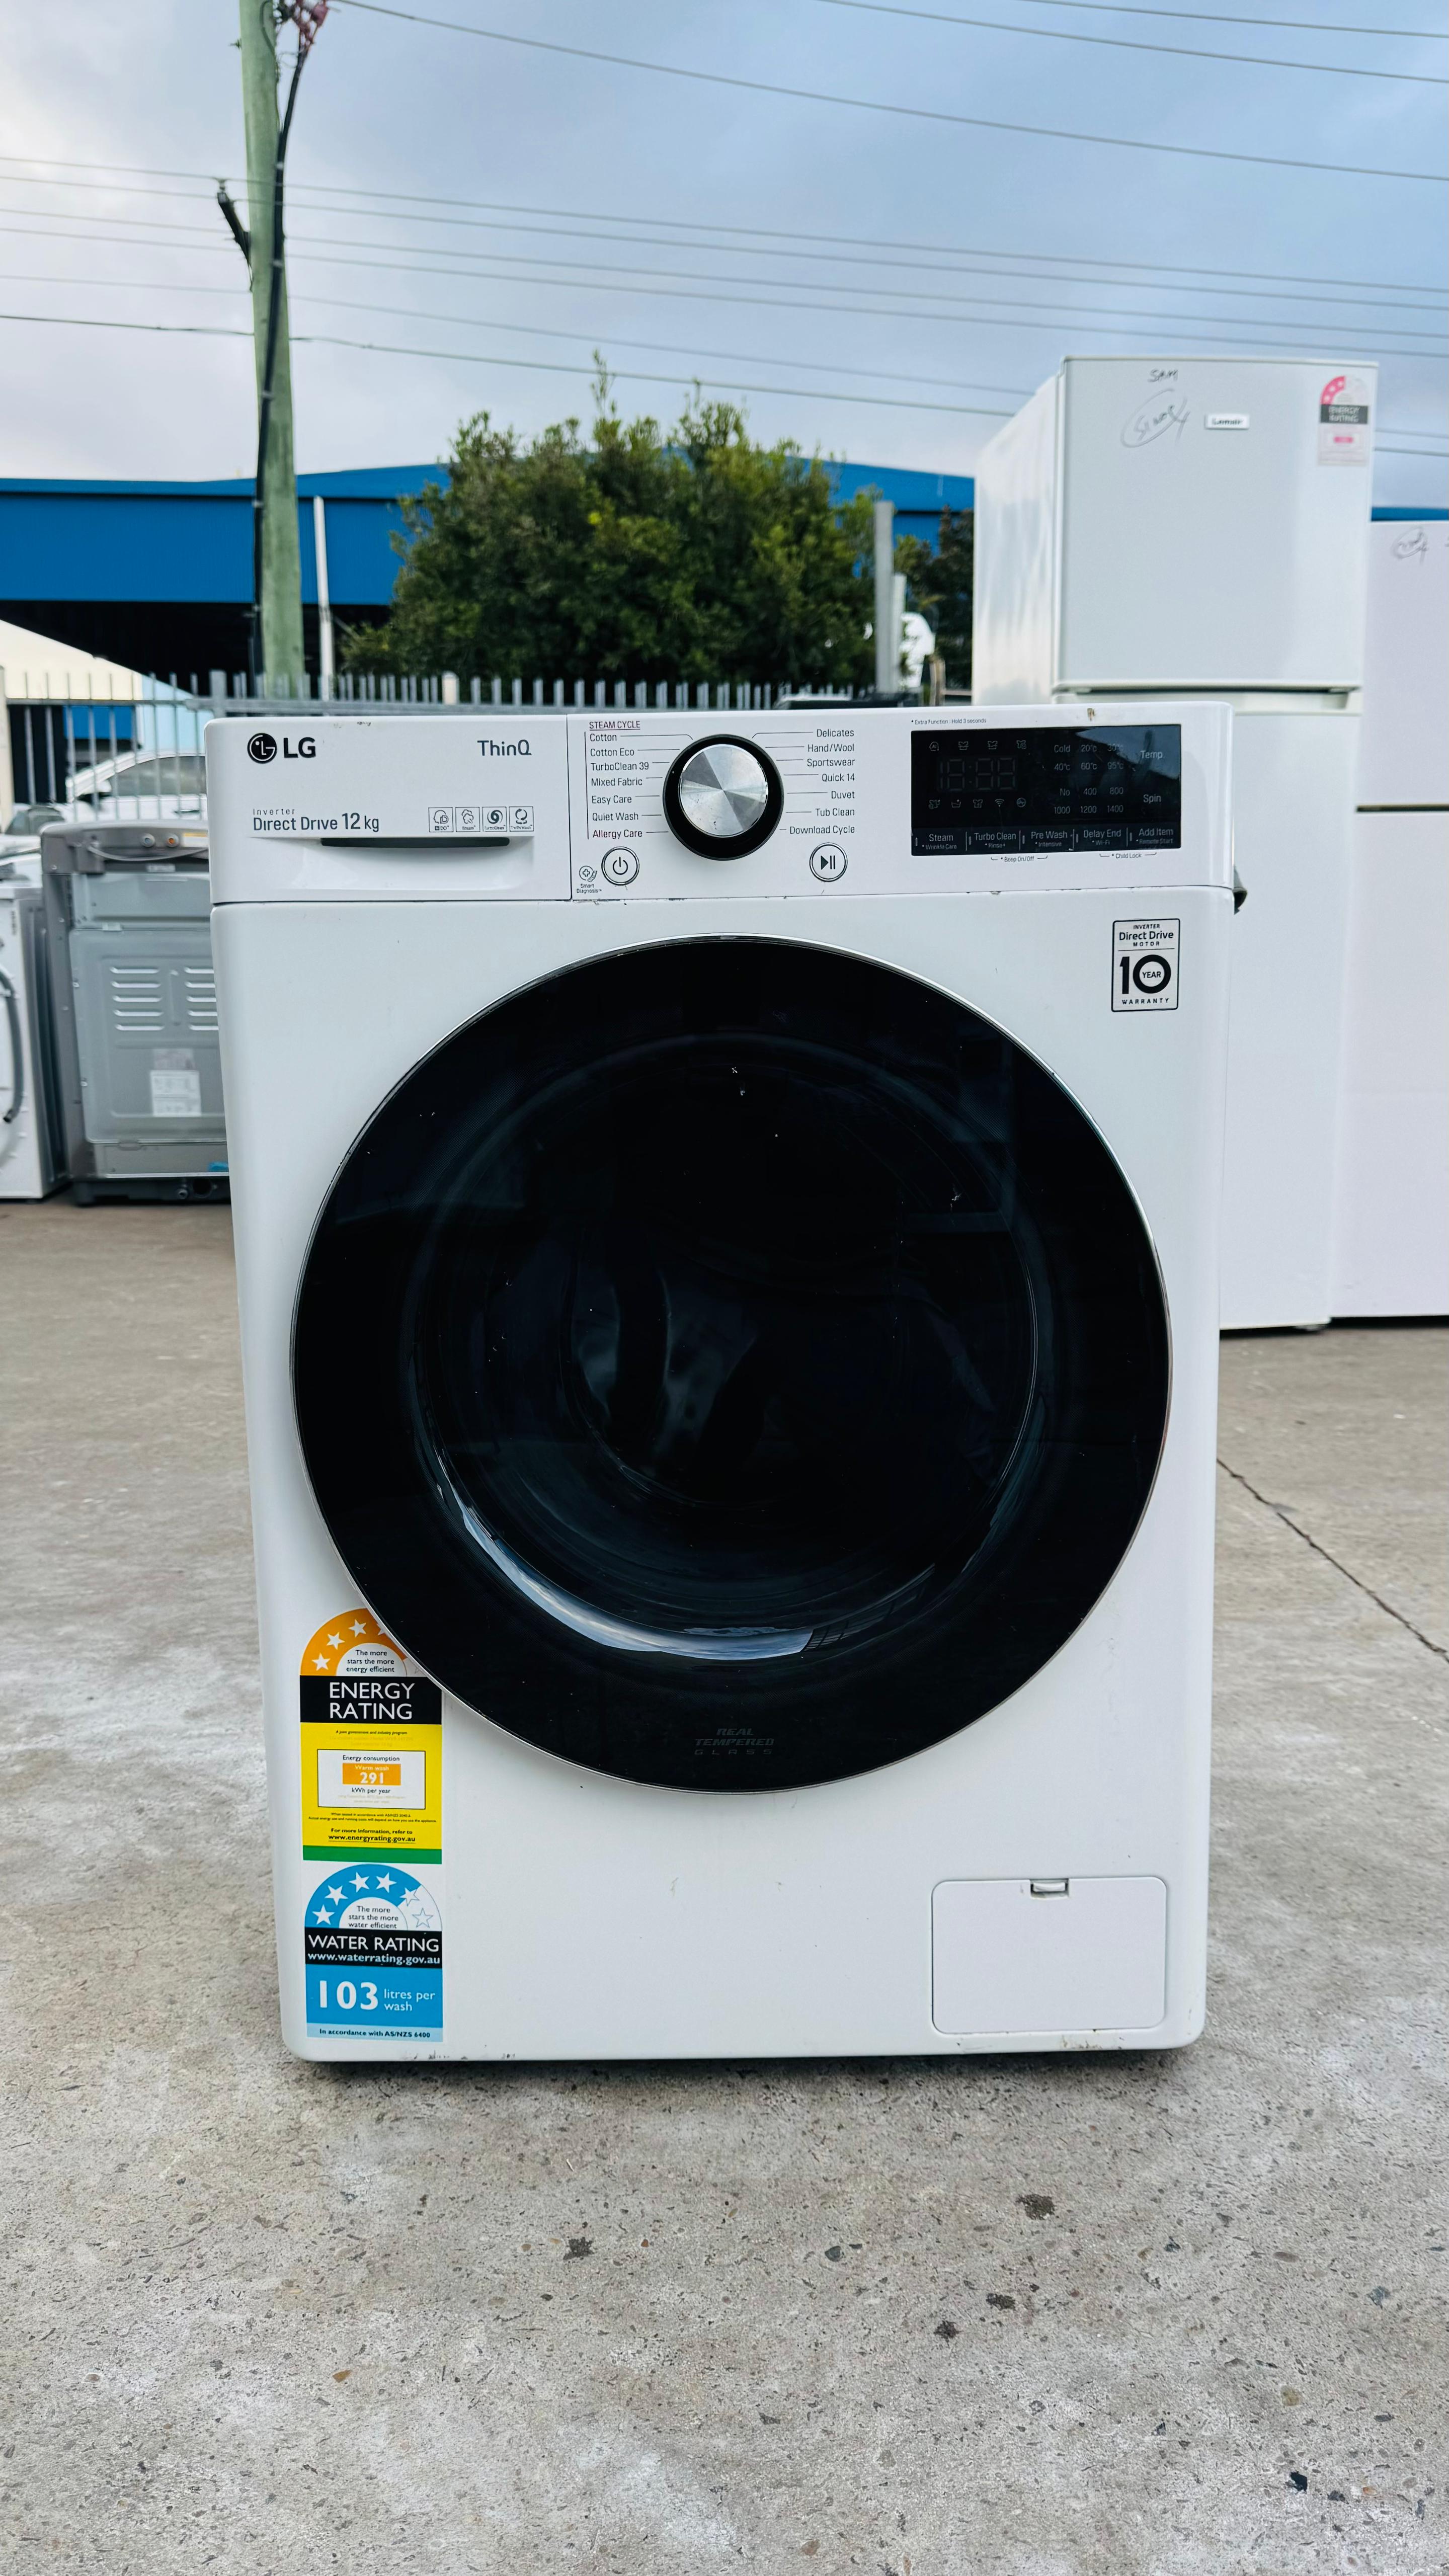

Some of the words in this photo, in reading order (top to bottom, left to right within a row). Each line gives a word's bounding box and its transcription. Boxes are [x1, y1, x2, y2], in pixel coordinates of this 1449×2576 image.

[589, 721, 615, 730] STEAM
[617, 720, 640, 729] CYCLE
[590, 733, 617, 742] Cotton
[817, 729, 855, 737] Delicates
[283, 737, 316, 759] LG
[477, 739, 532, 756] ThinQ
[590, 748, 617, 757] Cotton
[619, 748, 634, 756] Eco
[808, 743, 855, 752] Hand/Wool
[1054, 744, 1071, 753] Cold
[591, 762, 637, 771] TurboClean
[639, 762, 649, 770] 39
[807, 758, 856, 768] Sportswear
[591, 777, 615, 786] Mixed
[618, 777, 643, 786] Fabric
[822, 773, 845, 782] Quick
[847, 773, 855, 781] 14
[831, 790, 855, 799] Duvet
[1060, 788, 1071, 796] No
[1109, 787, 1124, 795] 800
[592, 795, 611, 805] Easy
[613, 794, 632, 803] Care
[1143, 793, 1162, 804] Spin
[815, 808, 831, 817] Tub
[832, 808, 855, 816] Clean
[1054, 806, 1071, 815] 1000
[1081, 806, 1097, 814] 1200
[1107, 805, 1124, 813] 1400
[592, 812, 614, 821] Quiet
[615, 812, 639, 821] Wash
[253, 817, 297, 831] Direct
[300, 816, 338, 831] Drive
[341, 812, 361, 830] 12
[364, 815, 379, 832] kg
[592, 829, 622, 840] Allergy
[623, 829, 642, 838] Care
[789, 826, 831, 835] Download
[832, 825, 855, 835] Cycle
[1031, 831, 1044, 839] Pre
[1045, 830, 1068, 839] Wash
[1083, 830, 1105, 840] Delay
[1106, 829, 1122, 838] End
[1139, 828, 1156, 837] Add
[1157, 828, 1174, 836] Item
[929, 833, 954, 842] Steam
[974, 833, 995, 841] Turbo
[996, 832, 1017, 840] Clean
[1119, 931, 1147, 940] Direct
[1149, 930, 1174, 940] Drive
[1119, 954, 1172, 995] 10
[329, 1681, 415, 1700] ENERGY
[330, 1702, 413, 1720] RATING
[360, 1772, 384, 1784] 291
[328, 1834, 417, 1843] www.energyrating.gov.au
[308, 1935, 369, 1950] WATER
[374, 1937, 440, 1952] RATING
[307, 1953, 441, 1966] www.waterrating.gov.au
[319, 1980, 378, 2010] 103
[383, 1989, 412, 1999] litres
[416, 1991, 435, 2002] per
[383, 2001, 413, 2011] wash
